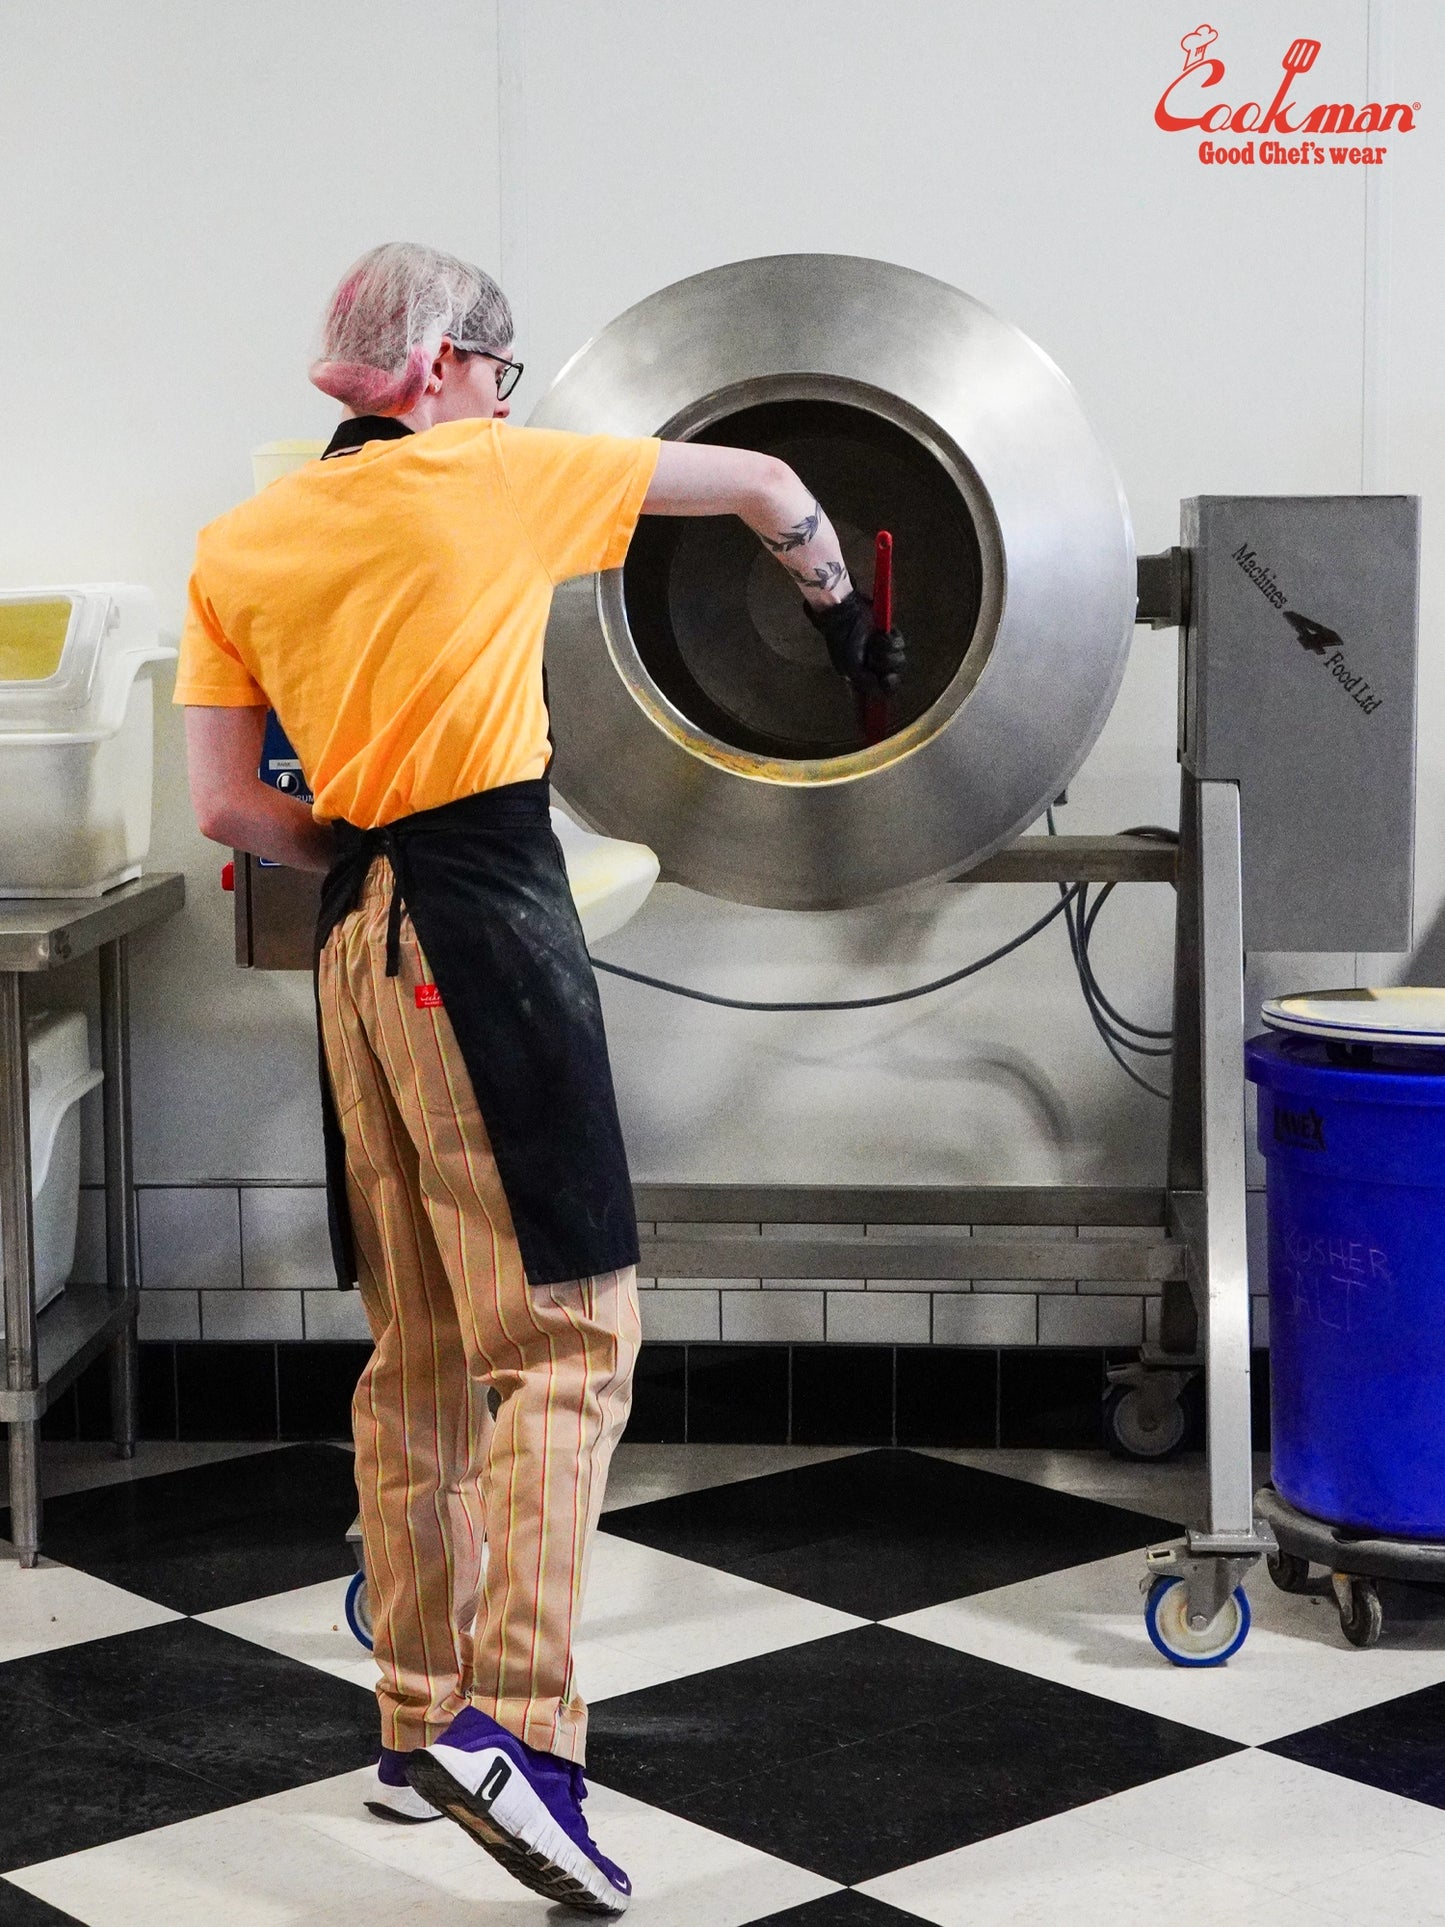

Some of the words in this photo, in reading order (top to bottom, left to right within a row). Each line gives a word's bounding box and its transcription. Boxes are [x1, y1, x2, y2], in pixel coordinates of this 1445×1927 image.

[1231, 542, 1288, 609] Machines
[1282, 611, 1344, 655] 4
[1323, 651, 1363, 692] Food
[1351, 683, 1383, 715] Ltd
[1284, 1227, 1393, 1284] KOSHER
